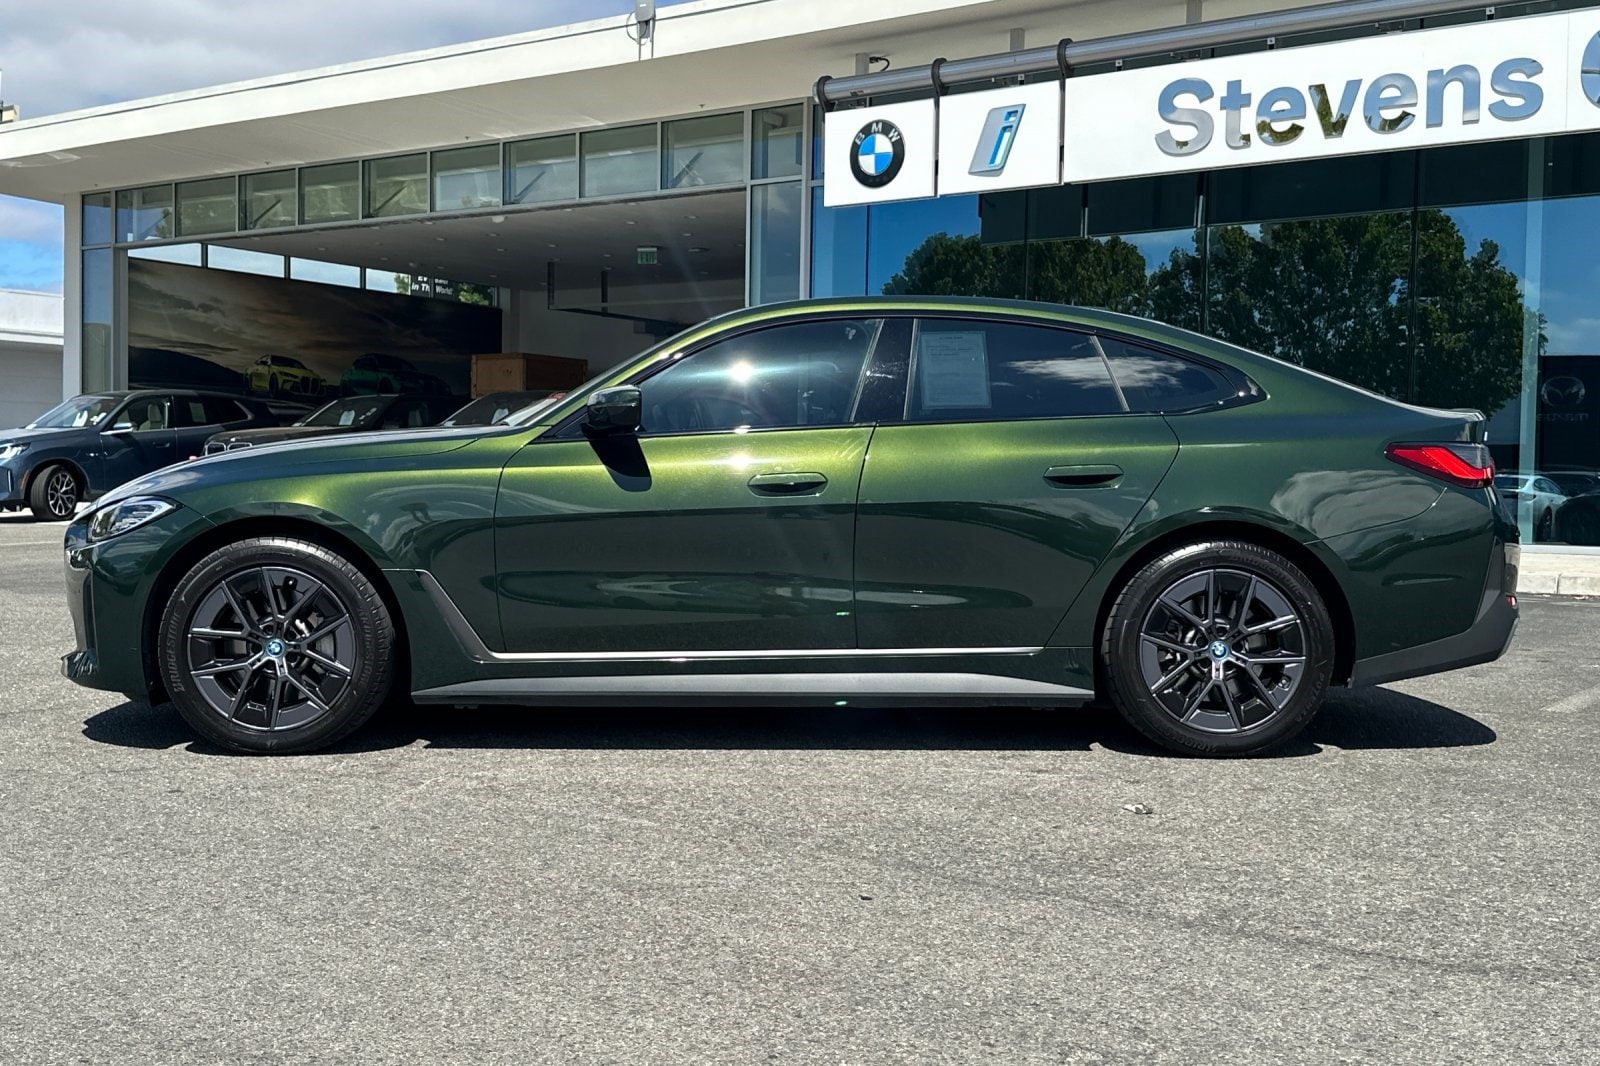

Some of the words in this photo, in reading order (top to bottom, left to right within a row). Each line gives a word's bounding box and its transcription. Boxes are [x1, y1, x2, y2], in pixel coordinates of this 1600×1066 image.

[1155, 57, 1544, 157] Stevens
[855, 121, 901, 146] BMW
[421, 283, 430, 292] Th
